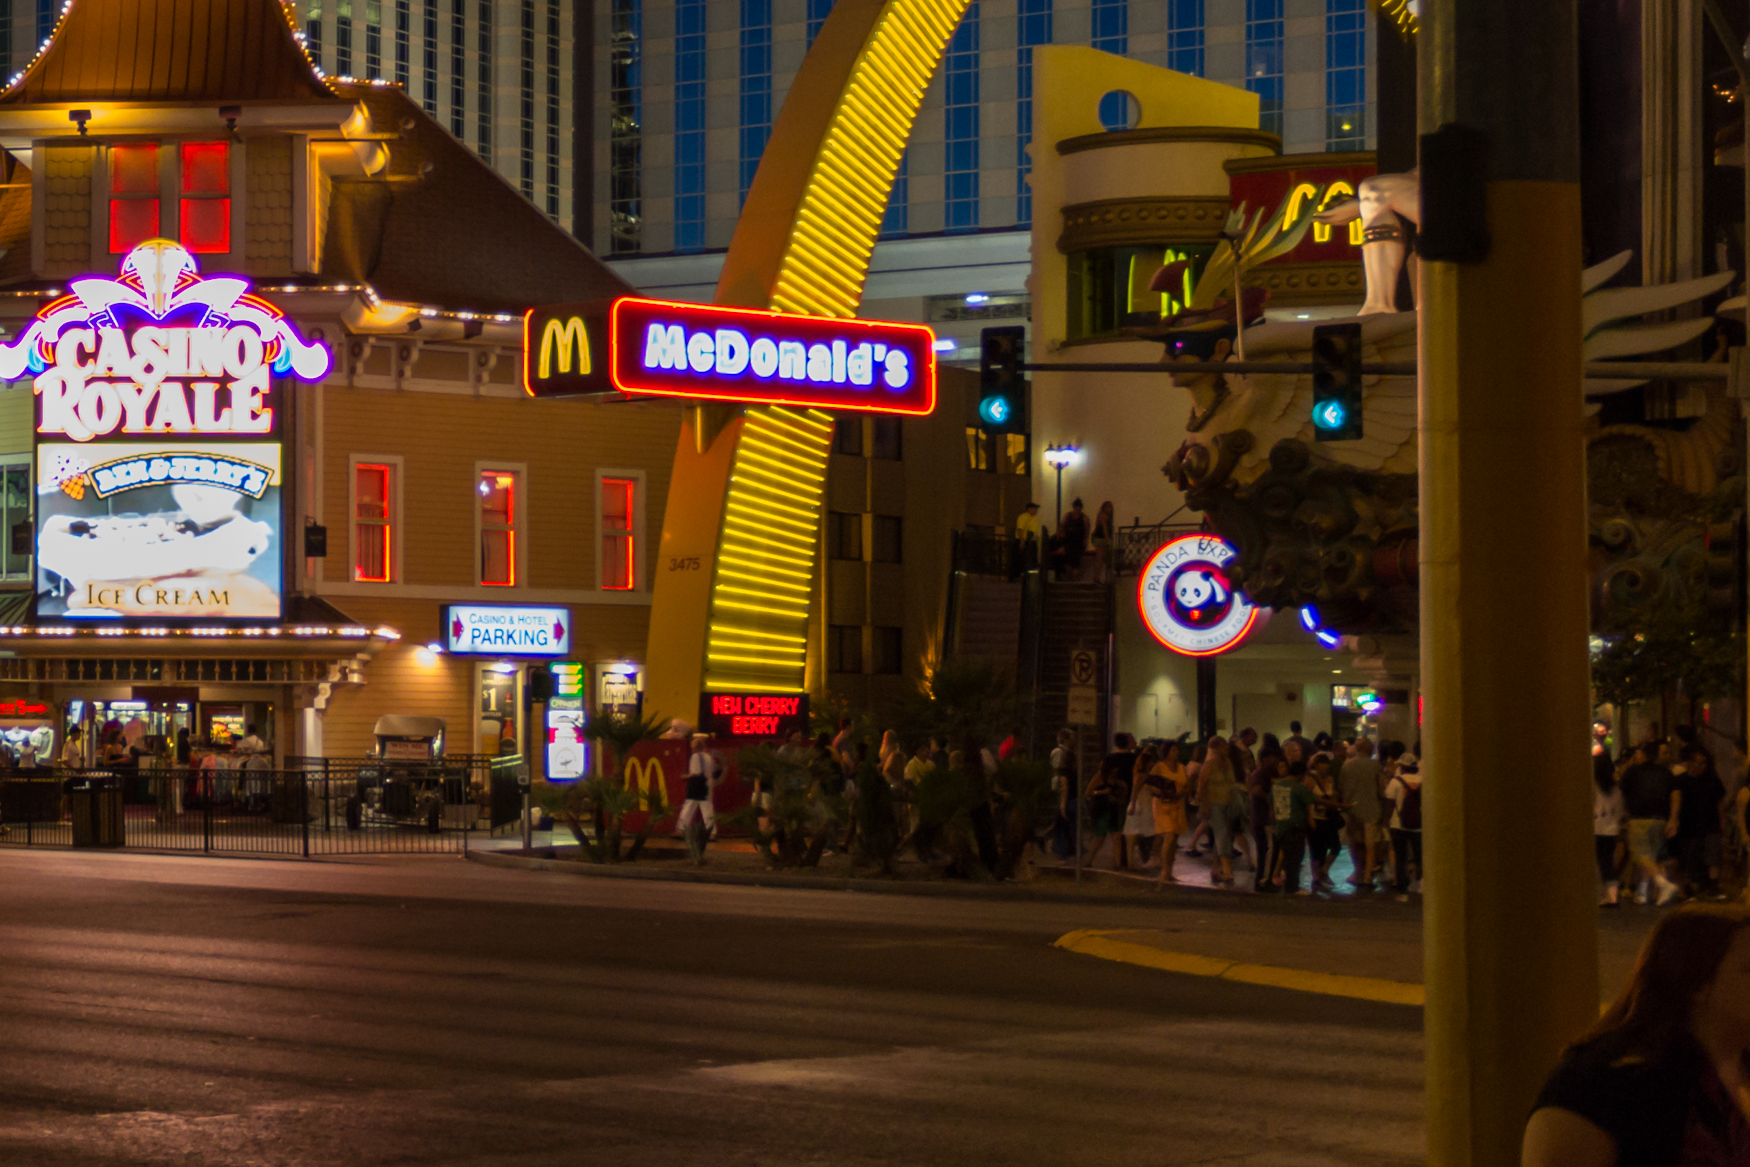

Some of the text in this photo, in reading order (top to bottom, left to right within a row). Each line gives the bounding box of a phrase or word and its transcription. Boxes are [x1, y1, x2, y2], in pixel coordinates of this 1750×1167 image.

[55, 324, 263, 384] CASINO
[644, 323, 909, 389] McDonald's
[34, 364, 273, 442] ROYALE
[669, 557, 700, 571] 3475
[1148, 546, 1190, 592] PANDA
[87, 583, 230, 607] ICE CREAM
[468, 613, 507, 625] CASINO
[517, 614, 549, 626] HOTEL
[470, 627, 549, 646] PARKING
[1190, 631, 1231, 646] CHINESE
[712, 695, 800, 715] NEW CHERRY
[732, 715, 779, 735] BERRY
